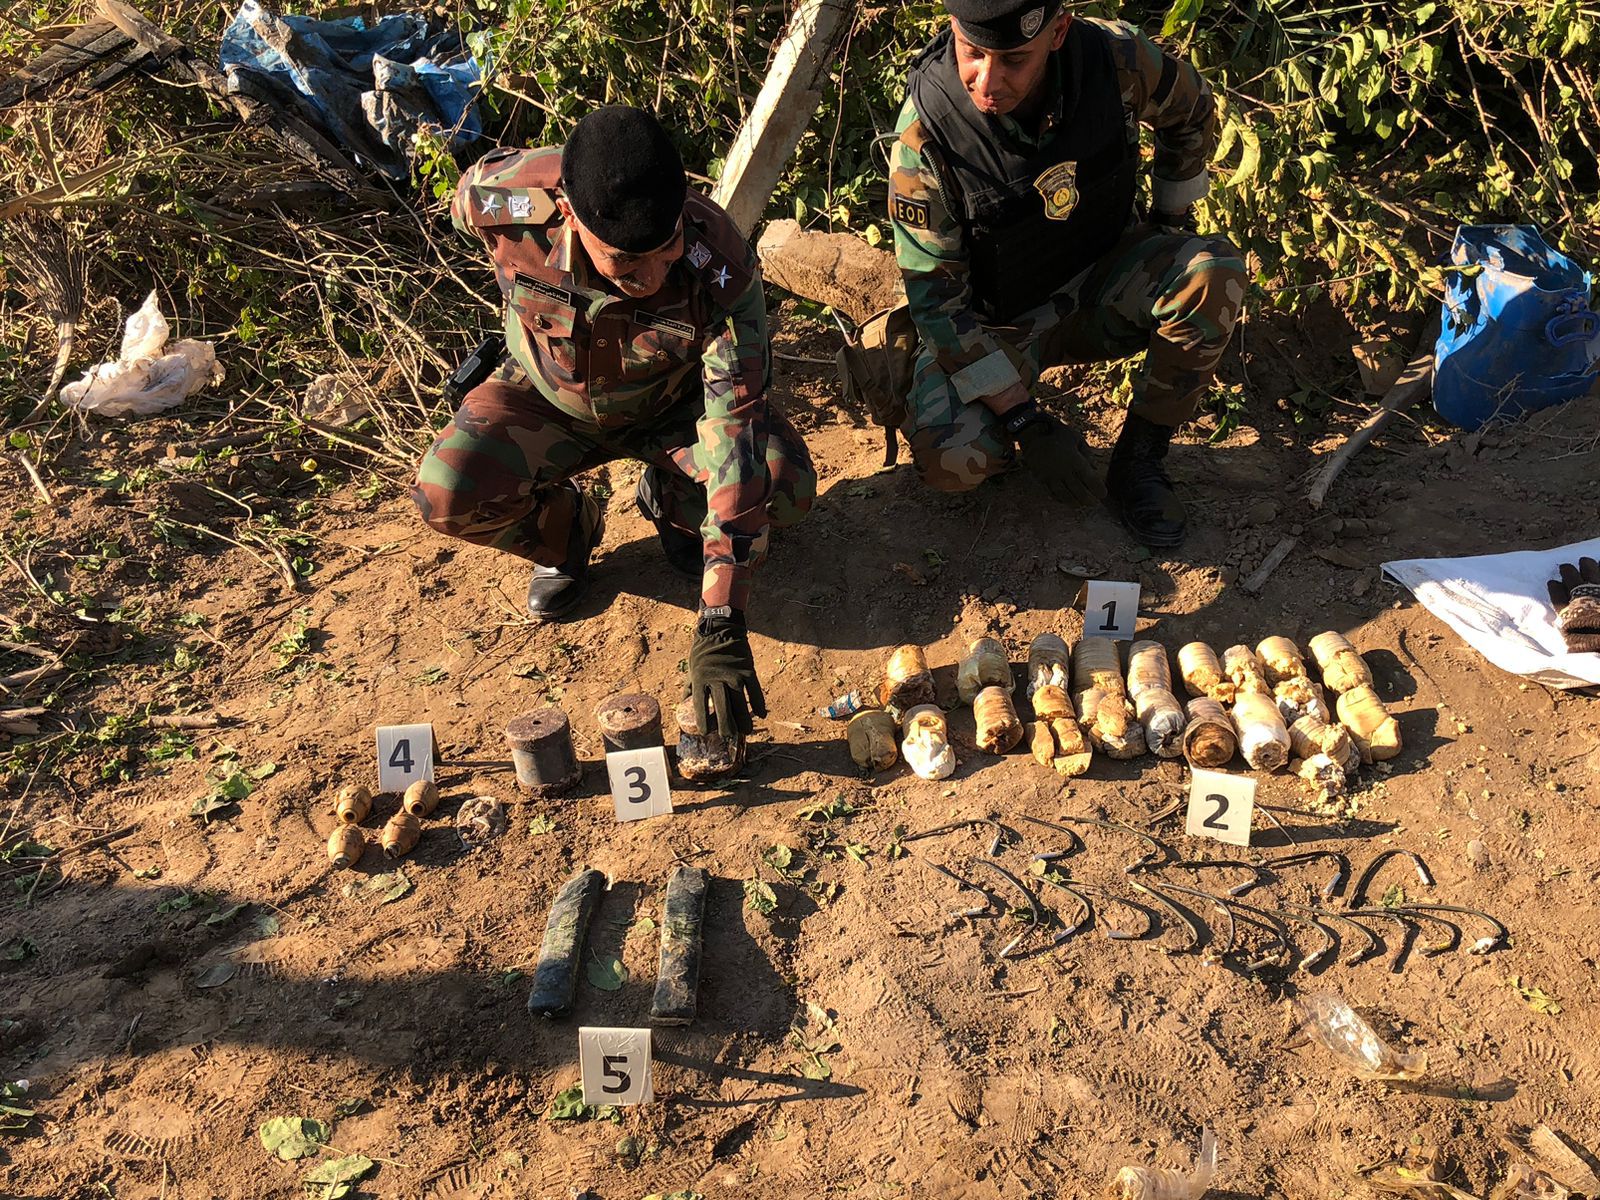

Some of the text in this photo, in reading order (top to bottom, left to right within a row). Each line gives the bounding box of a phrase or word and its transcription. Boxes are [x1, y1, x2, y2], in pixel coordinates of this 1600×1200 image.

[898, 202, 925, 224] EOD
[1099, 600, 1119, 631] 1
[389, 738, 415, 774] 4
[624, 766, 652, 804] 3
[1202, 793, 1230, 831] 2
[602, 1055, 631, 1094] 5
